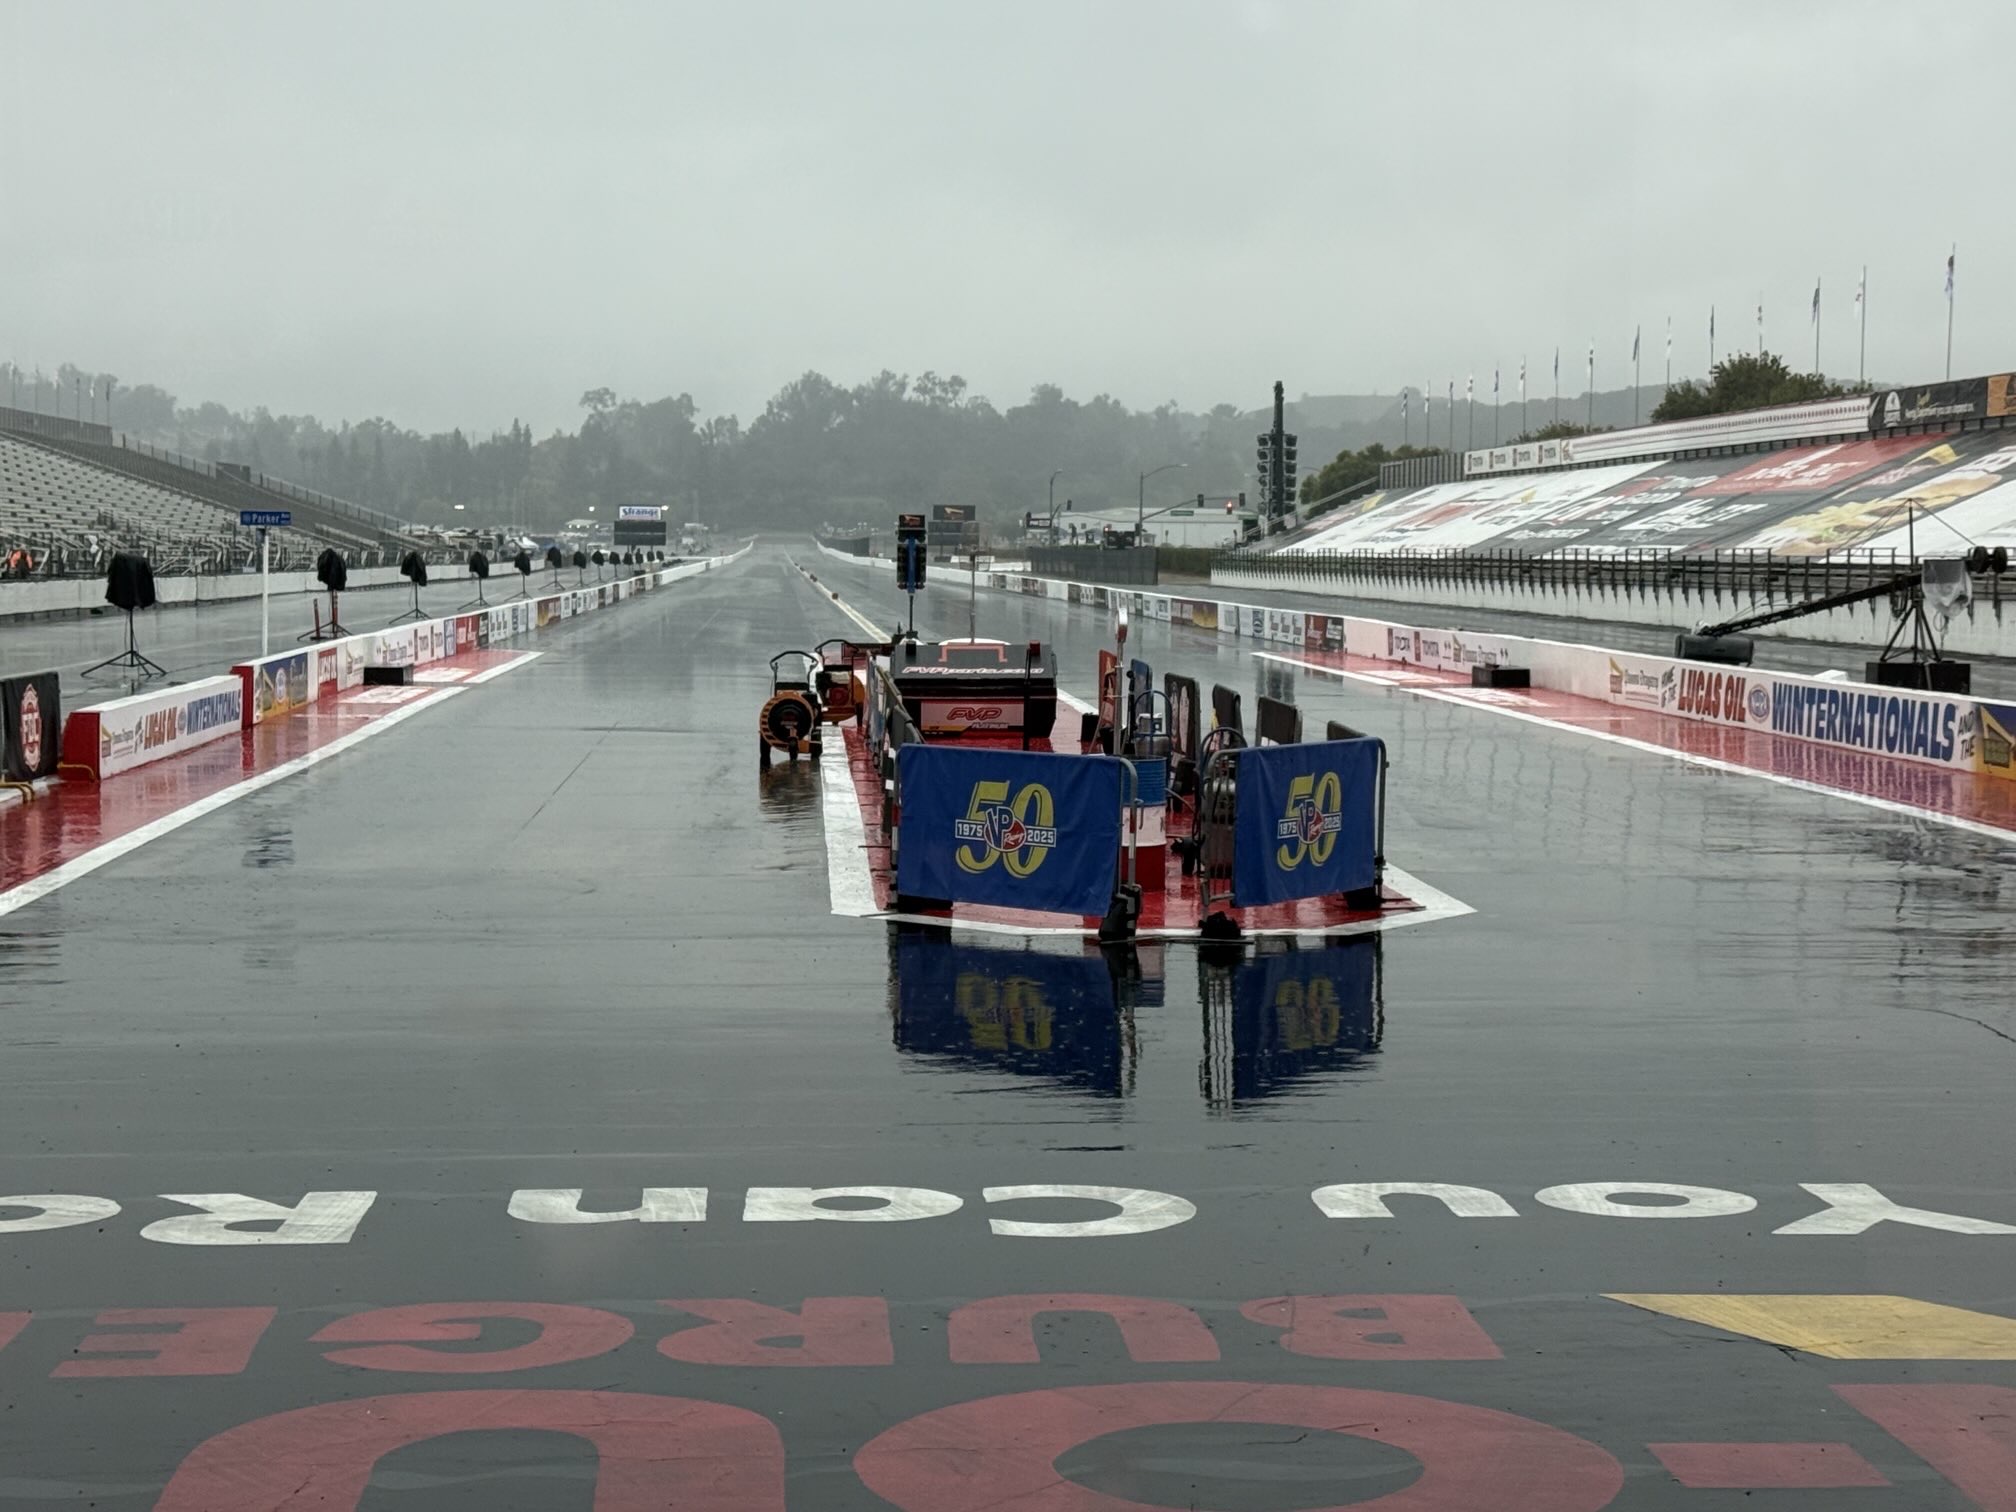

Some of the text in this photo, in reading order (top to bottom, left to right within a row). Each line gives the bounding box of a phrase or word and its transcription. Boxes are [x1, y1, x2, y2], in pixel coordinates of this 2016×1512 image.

[252, 513, 280, 523] Parker
[144, 709, 167, 751] LUCAS
[947, 707, 1002, 721] FVP
[1678, 668, 1722, 719] LUCAS
[1724, 674, 1746, 722] OIL
[1772, 682, 1956, 762] WINTERNATIONALS
[956, 780, 1054, 878] 50
[957, 823, 983, 837] 1975
[1027, 829, 1054, 843] 2025
[1277, 772, 1341, 871] 50
[1280, 822, 1297, 835] 1975
[507, 1187, 1197, 1238] Can
[1311, 1182, 2016, 1236] You
[0, 1293, 1506, 1378] BURGE
